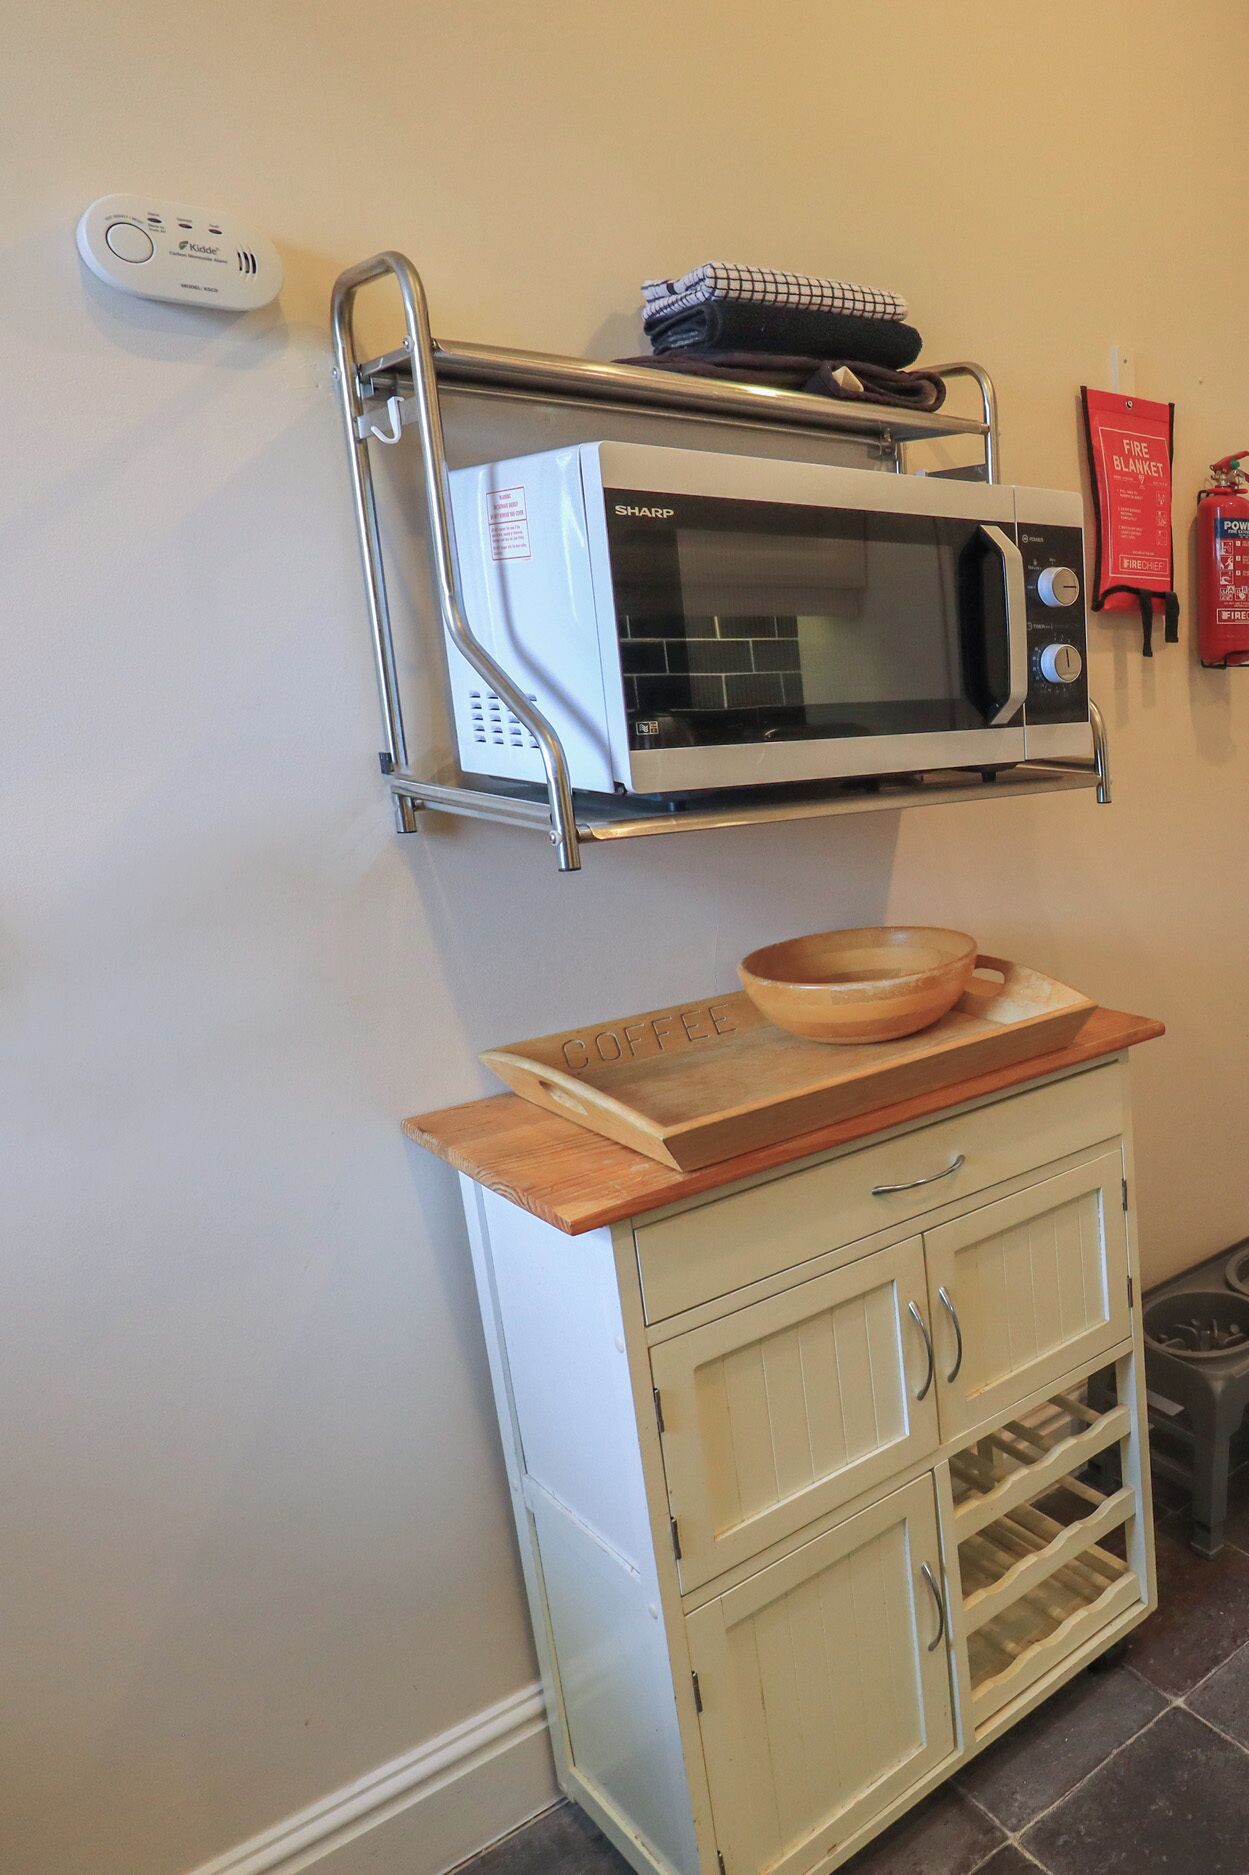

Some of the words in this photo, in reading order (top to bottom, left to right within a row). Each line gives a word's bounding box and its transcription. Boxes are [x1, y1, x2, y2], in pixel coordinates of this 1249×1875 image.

[189, 243, 217, 255] Kidde
[1122, 439, 1150, 458] FIRE
[1112, 455, 1164, 479] BLANKET
[614, 504, 674, 518] SHARP
[1123, 558, 1164, 571] FIRECHIEF
[562, 1002, 737, 1070] COFFEE
